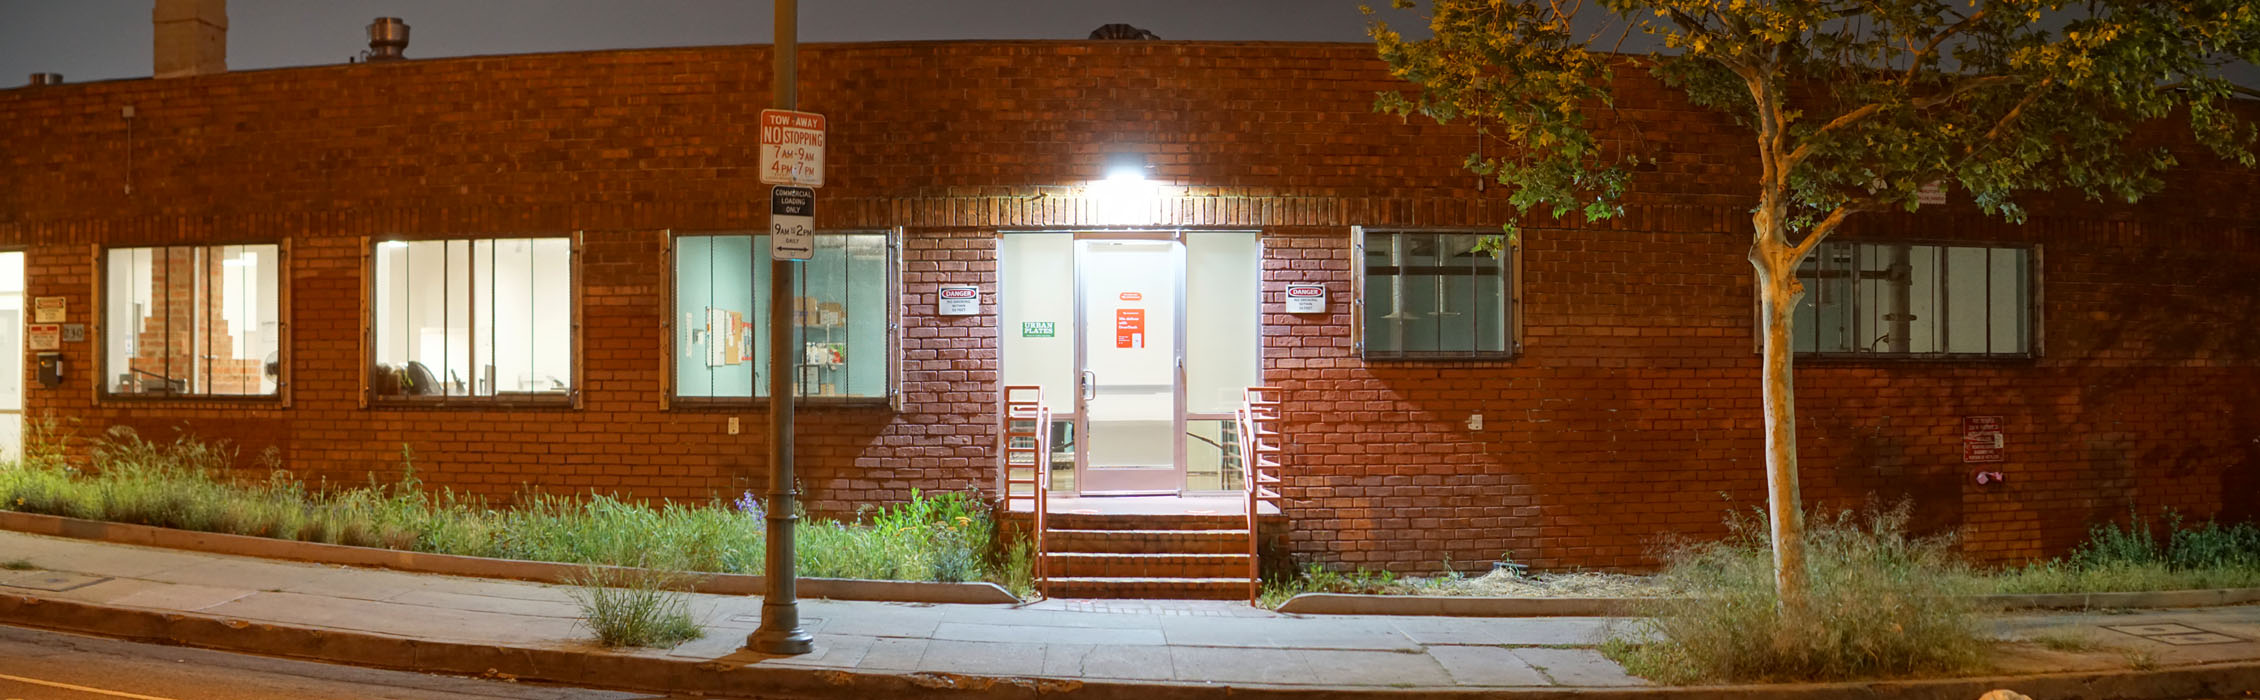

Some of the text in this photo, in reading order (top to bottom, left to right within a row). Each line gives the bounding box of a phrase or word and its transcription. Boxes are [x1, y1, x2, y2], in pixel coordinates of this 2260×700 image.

[764, 126, 823, 148] NO STOPPING
[775, 188, 812, 198] COMMERCIAL
[781, 197, 806, 206] LOADING
[785, 206, 801, 214] ONLY
